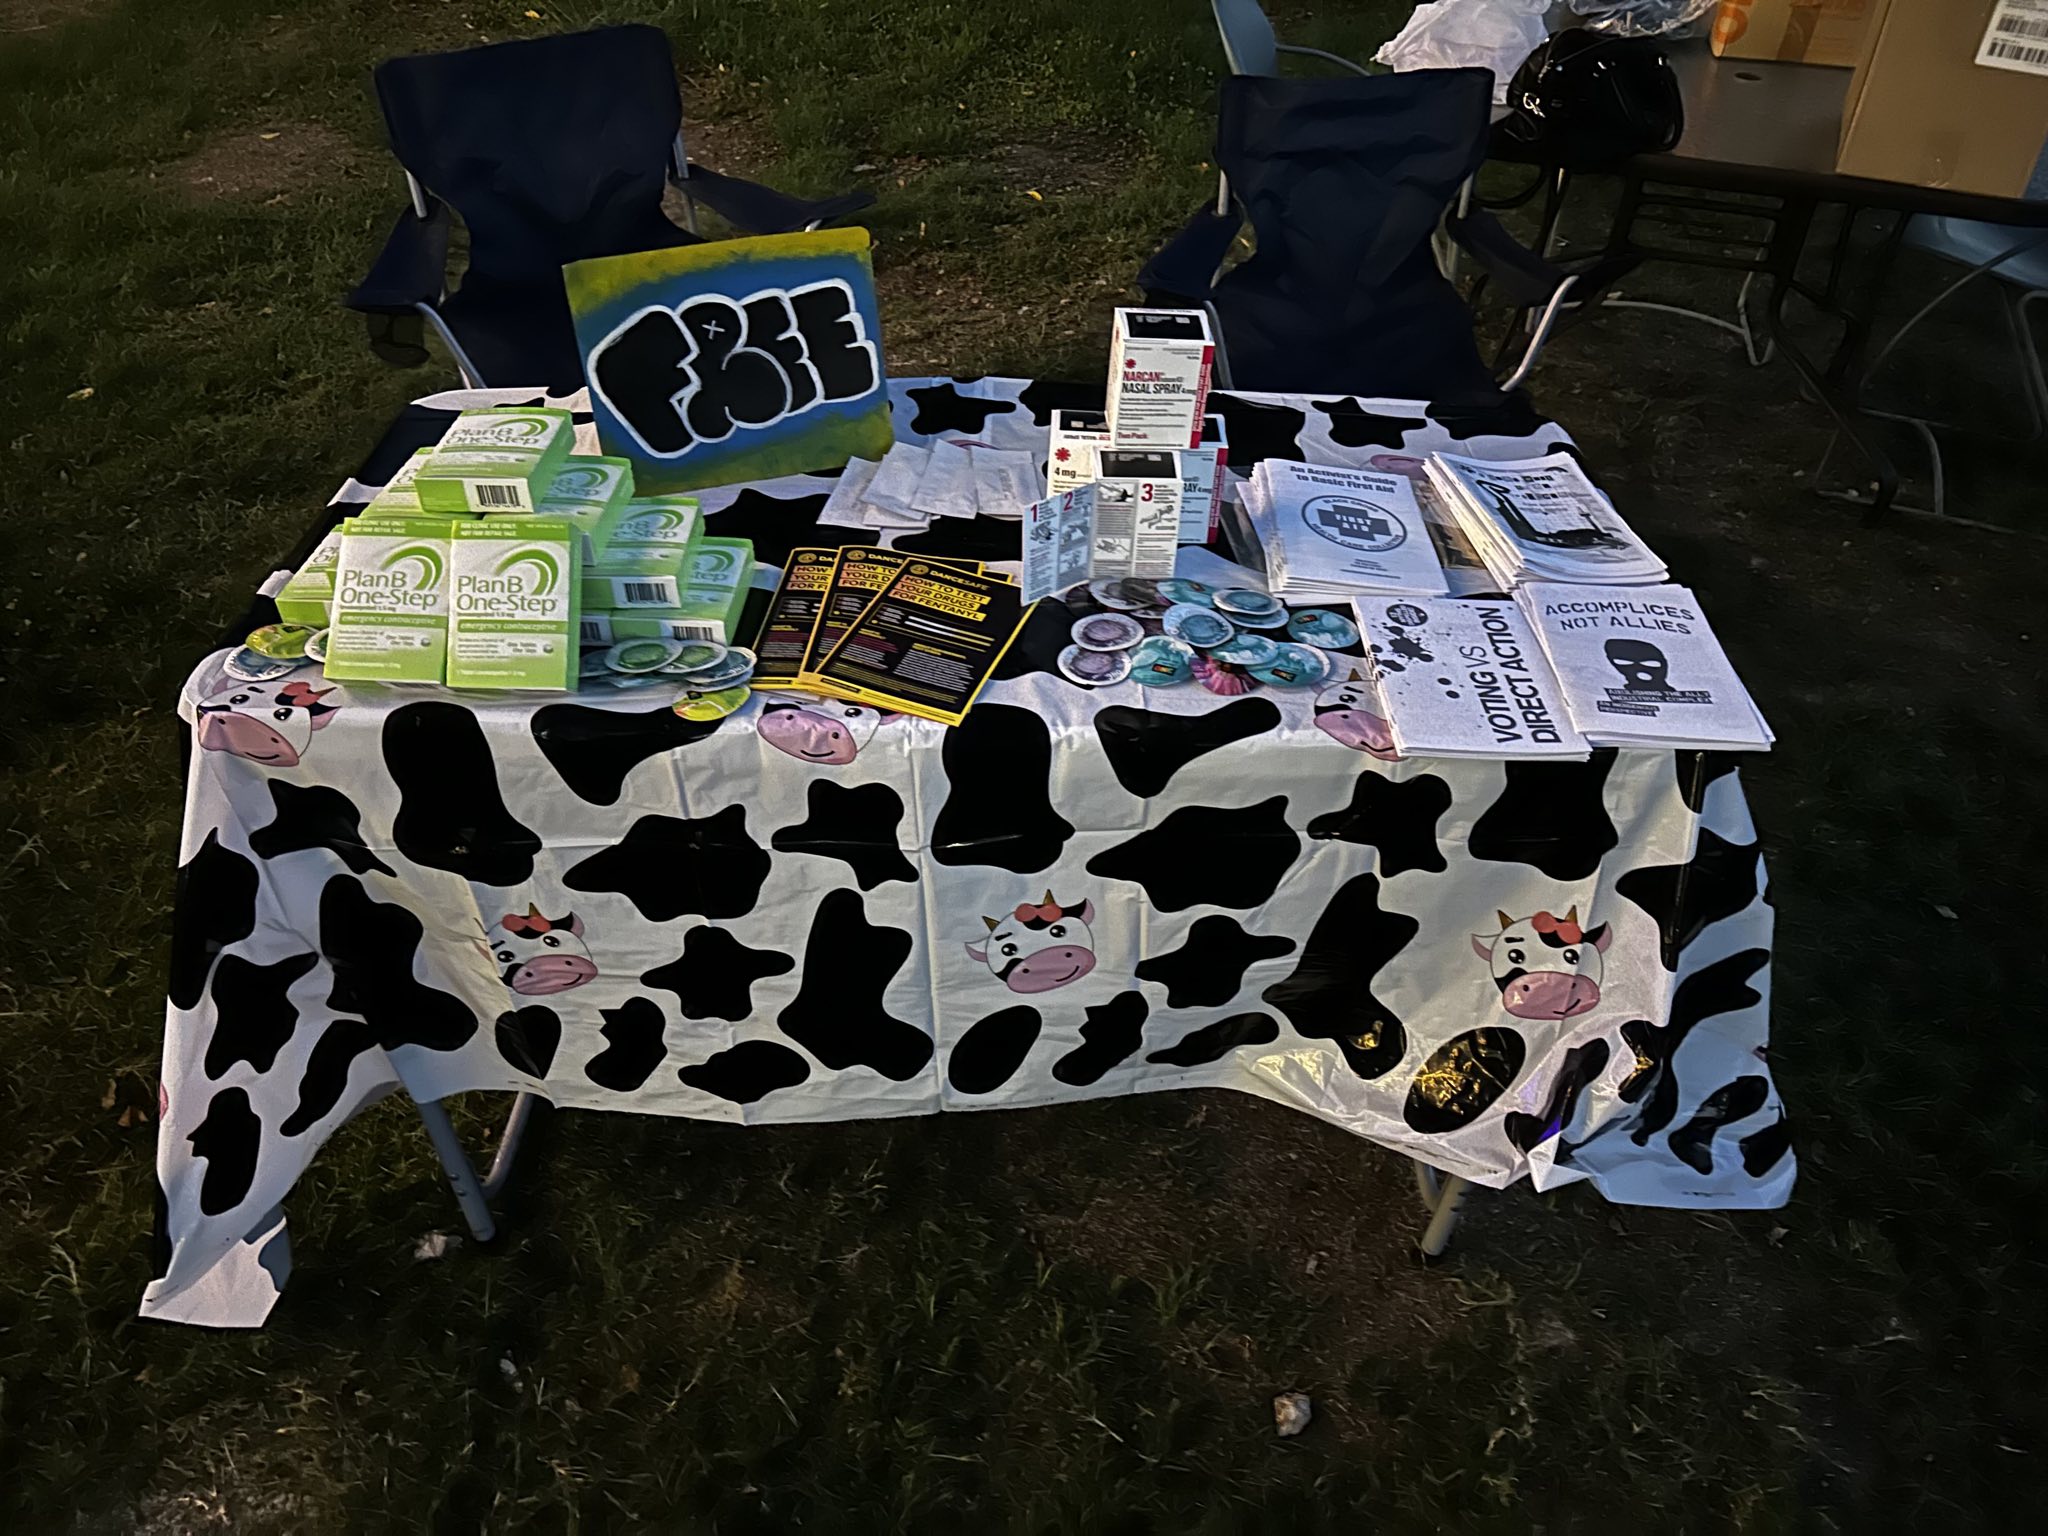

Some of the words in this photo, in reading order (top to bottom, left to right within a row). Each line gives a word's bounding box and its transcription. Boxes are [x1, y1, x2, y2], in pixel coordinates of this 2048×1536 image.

[587, 278, 880, 459] FREE
[1122, 371, 1161, 382] NARCAN
[1121, 382, 1151, 394] NASAL
[1153, 384, 1182, 394] SPRAY
[1054, 467, 1060, 476] 4
[1061, 469, 1076, 479] mg
[1307, 467, 1361, 480] Activist's
[1362, 475, 1397, 486] Guide
[1140, 483, 1154, 502] 3
[1311, 476, 1345, 487] Basic
[1346, 480, 1374, 491] First
[1375, 485, 1396, 493] Aid
[1063, 491, 1073, 512] 2
[1030, 504, 1038, 523] 1
[1334, 513, 1372, 526] FIRST
[1342, 522, 1370, 532] AID
[868, 553, 904, 564] DANCE
[793, 574, 829, 582] YOUR
[796, 565, 828, 574] HOW
[844, 571, 879, 581] YOUR
[846, 562, 877, 572] HOW
[880, 566, 899, 575] TO
[790, 582, 816, 590] FOR
[841, 579, 867, 588] FOR
[904, 575, 935, 589] HOW
[936, 582, 954, 594] TO
[955, 587, 986, 603] TEST
[340, 588, 438, 611] One-Step
[456, 594, 557, 616] One-Step
[891, 589, 917, 602] FOR
[918, 596, 981, 619] FENTANYL
[899, 584, 933, 598] YOUR
[933, 592, 976, 609] DRUGS
[342, 616, 381, 624] emergency
[383, 616, 436, 625] contraceptive
[1545, 602, 1696, 621] ACCOMPLICES
[460, 621, 501, 631] emergency
[503, 622, 557, 631] contraceptive
[1560, 616, 1599, 631] NOT
[1609, 616, 1692, 635] ALLIES
[1475, 607, 1529, 672] ACTION
[1458, 645, 1491, 668] VS
[1469, 671, 1523, 743] VOTING
[1504, 674, 1562, 743] DIRECT
